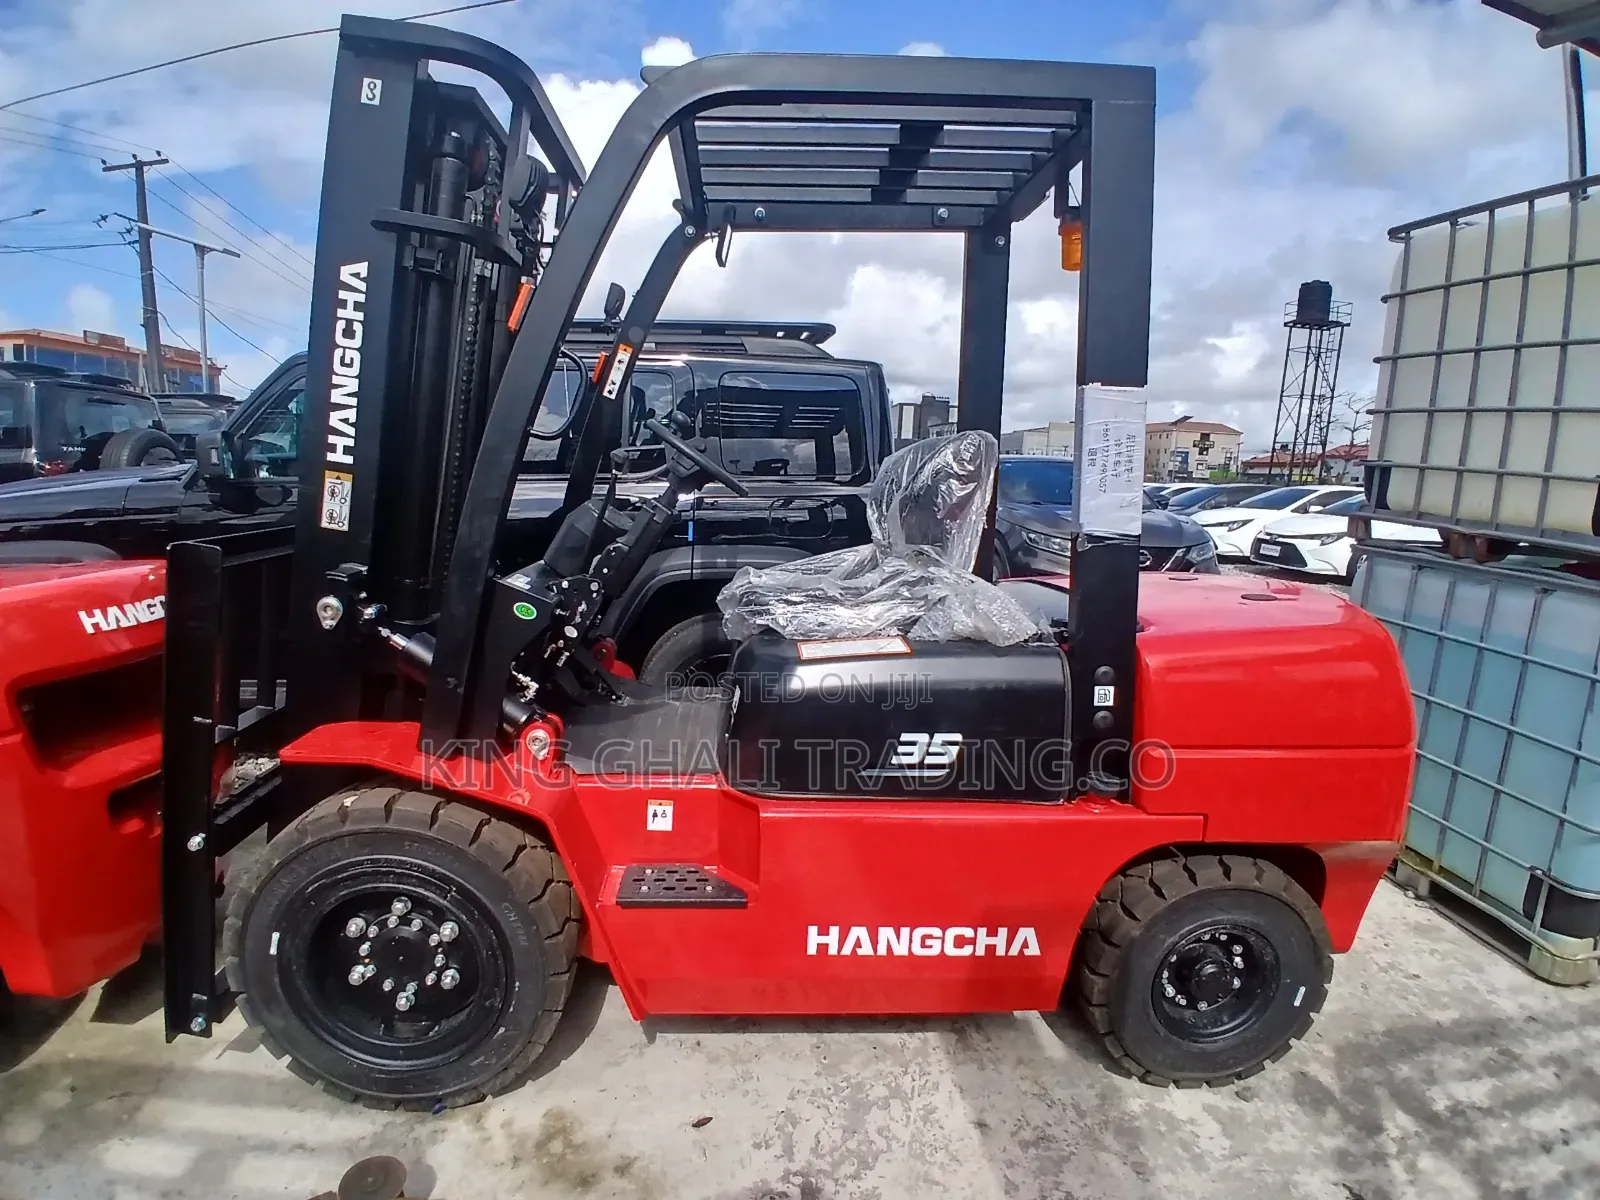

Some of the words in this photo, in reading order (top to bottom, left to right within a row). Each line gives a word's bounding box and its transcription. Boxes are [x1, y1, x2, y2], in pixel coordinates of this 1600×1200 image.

[326, 261, 368, 465] HANGCHA
[890, 732, 963, 765] 35
[806, 925, 1041, 956] HANGCHA
